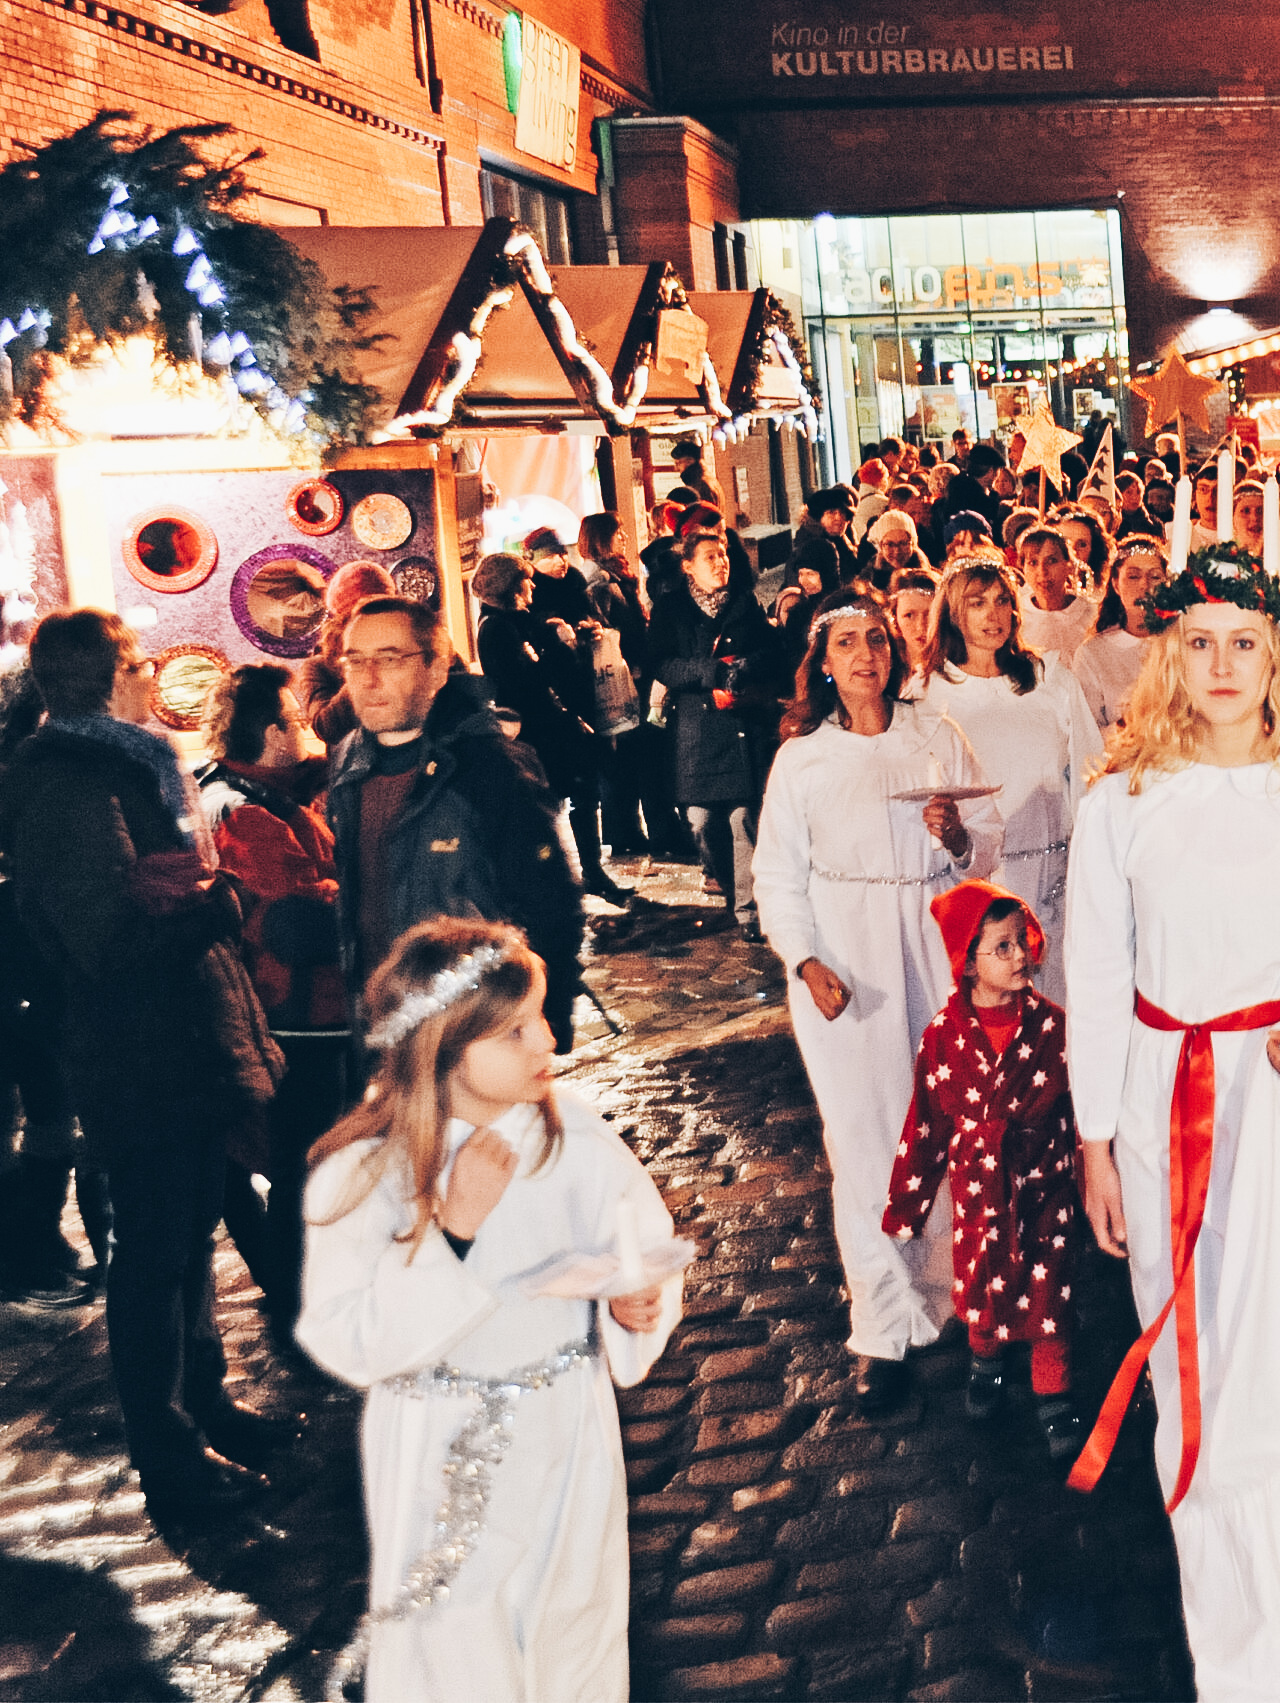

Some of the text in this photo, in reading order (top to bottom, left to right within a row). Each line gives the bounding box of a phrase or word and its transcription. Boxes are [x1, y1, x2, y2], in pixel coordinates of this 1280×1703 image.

[771, 20, 911, 46] Kino in der
[524, 18, 569, 85] green
[771, 46, 1074, 76] KULTURBRAUEREI
[943, 257, 1063, 300] eins
